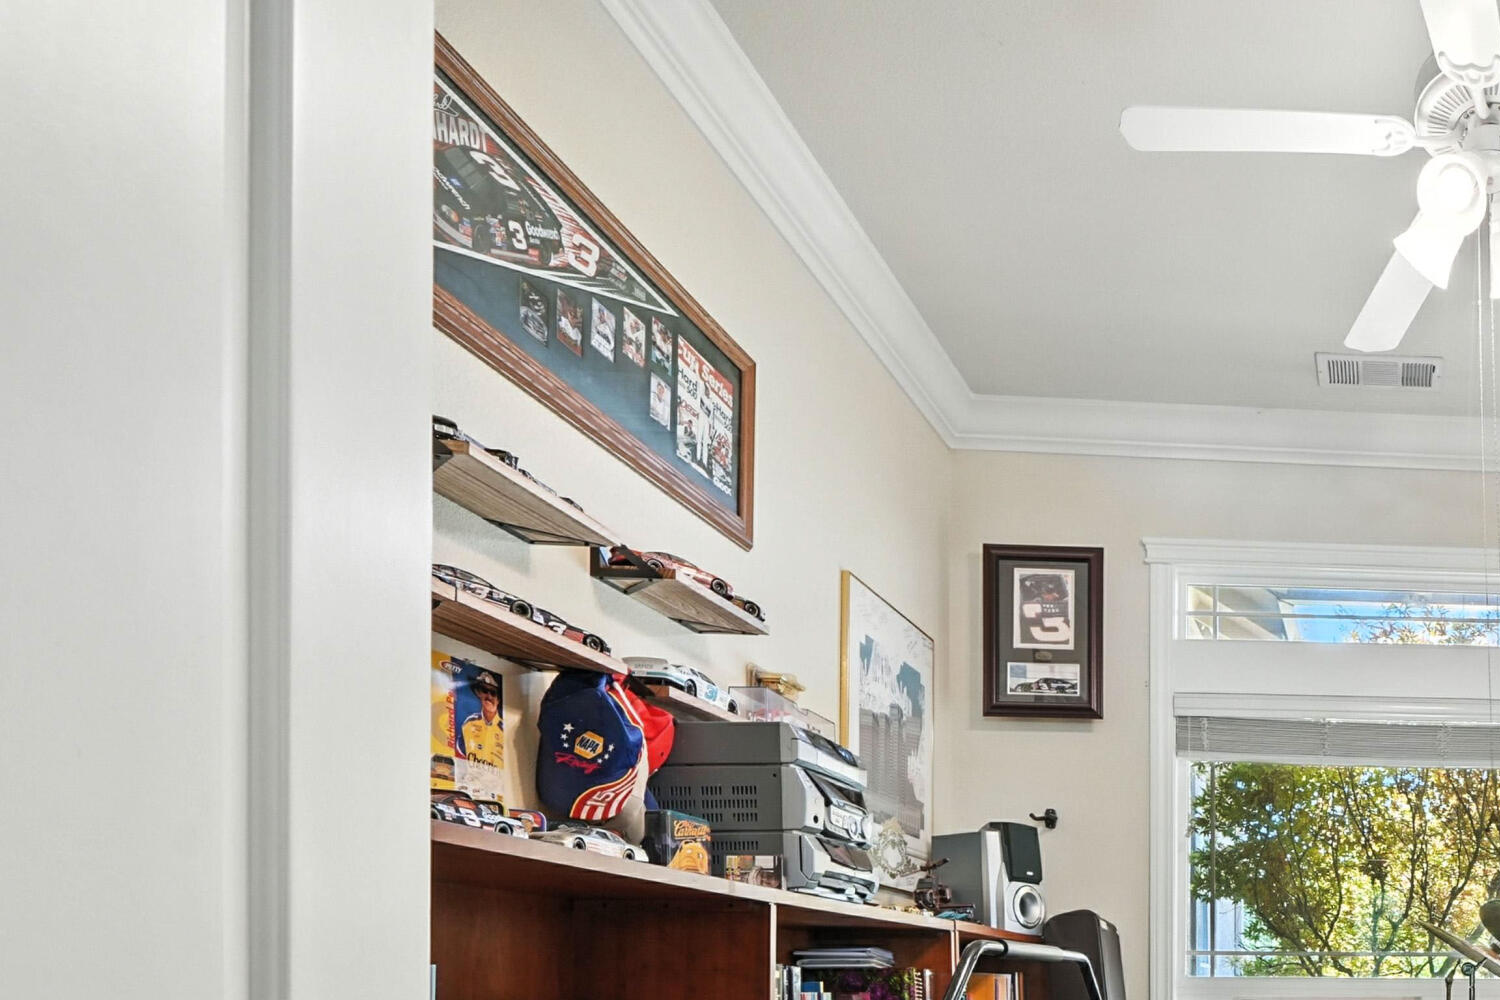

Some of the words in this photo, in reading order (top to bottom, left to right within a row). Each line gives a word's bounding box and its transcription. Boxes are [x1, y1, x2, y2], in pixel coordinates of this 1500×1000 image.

[433, 111, 488, 153] HARDT
[469, 150, 521, 191] 3
[508, 220, 528, 250] 3
[568, 233, 600, 277] 3
[576, 735, 600, 754] NAPA
